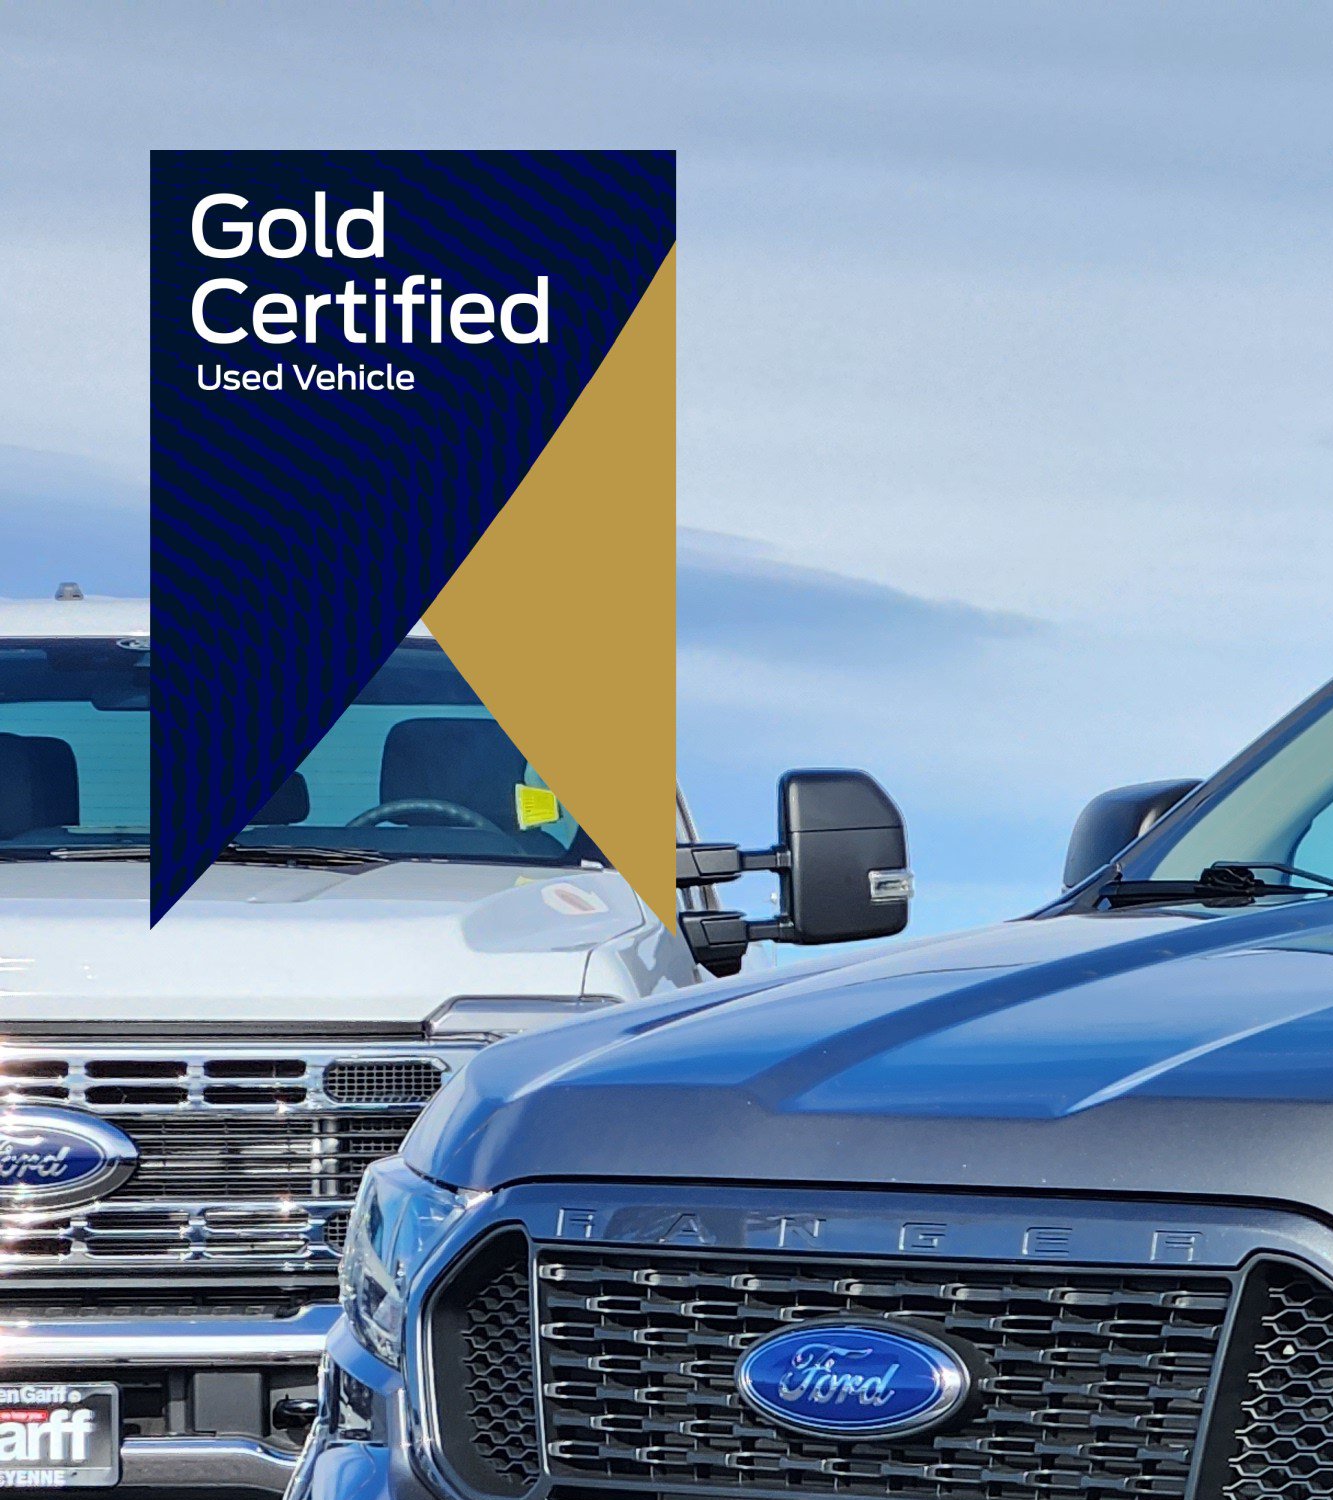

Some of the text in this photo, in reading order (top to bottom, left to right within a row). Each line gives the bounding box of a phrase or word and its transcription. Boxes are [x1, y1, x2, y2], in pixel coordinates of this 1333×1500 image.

[556, 1206, 1203, 1263] RANGER
[20, 1386, 67, 1404] Garff
[778, 1343, 899, 1407] Ford
